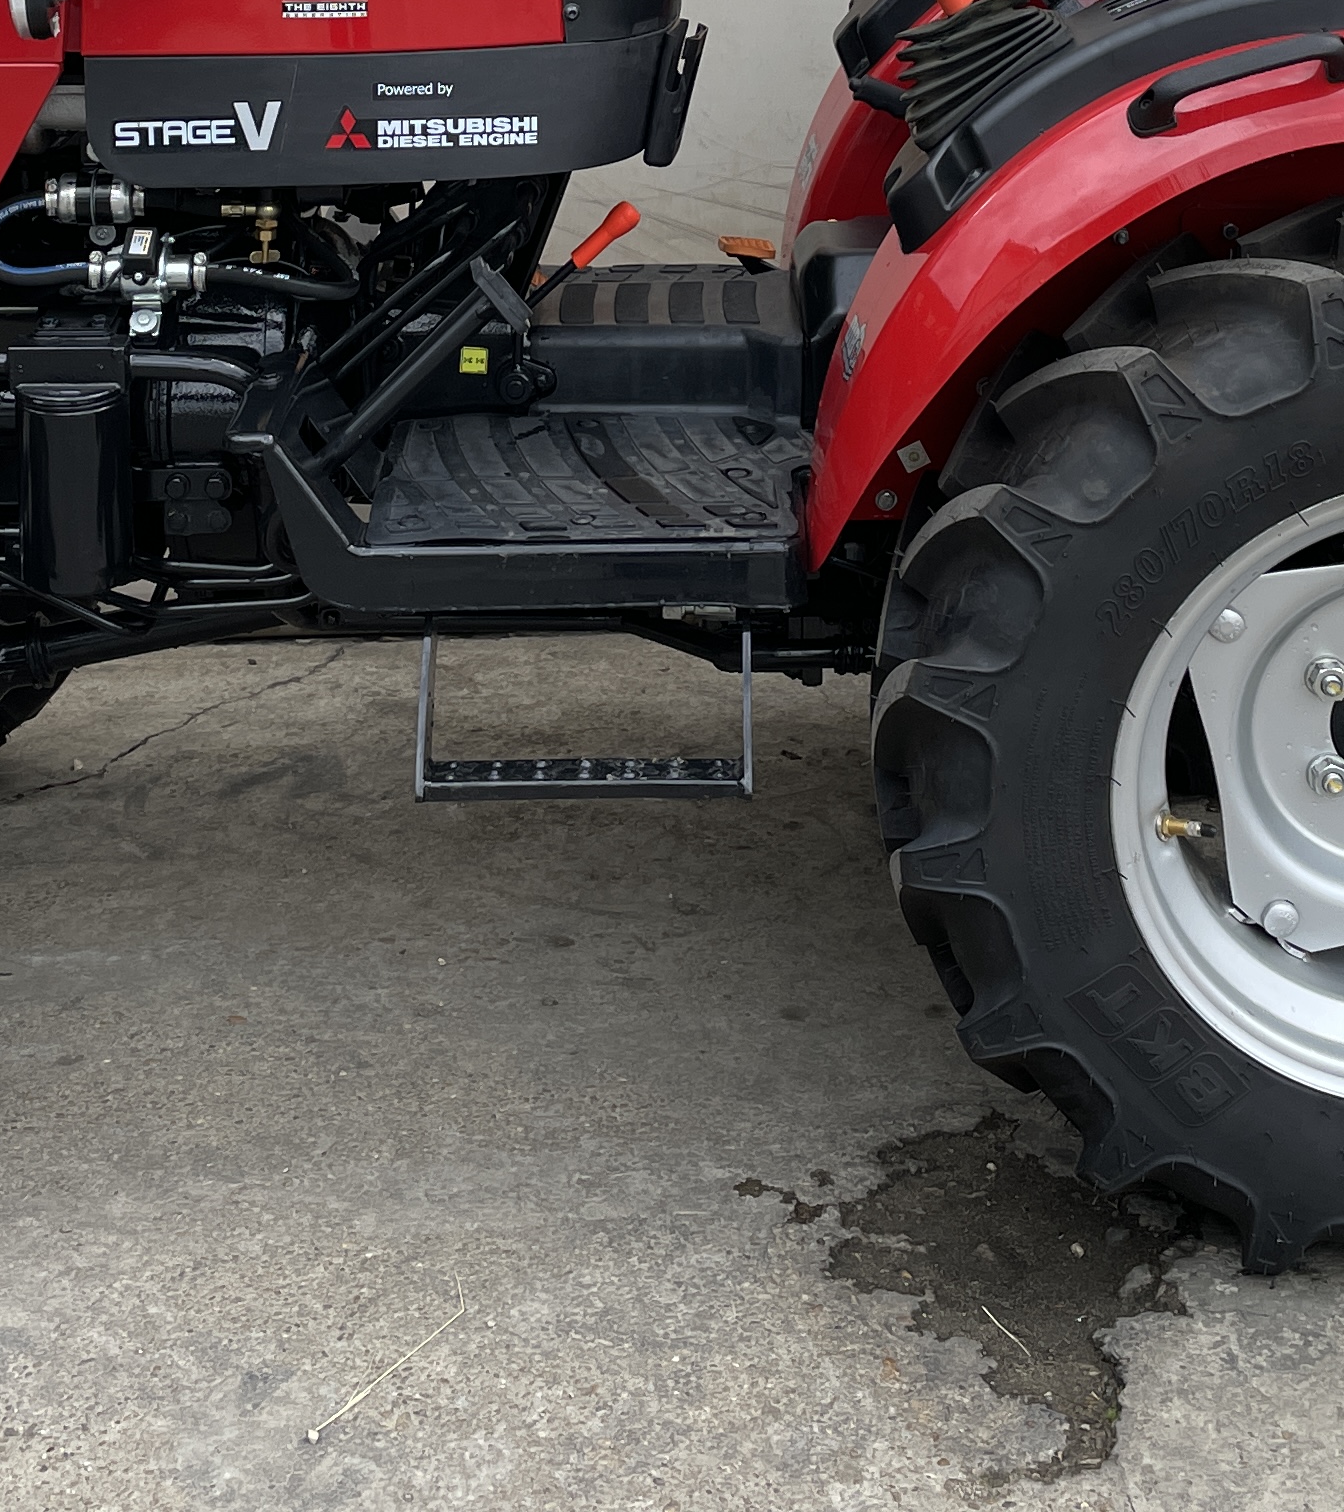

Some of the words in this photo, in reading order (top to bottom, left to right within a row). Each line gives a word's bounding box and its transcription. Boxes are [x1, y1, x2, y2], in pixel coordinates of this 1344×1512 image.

[285, 2, 312, 11] THE
[316, 2, 366, 11] EIGHTH
[377, 83, 433, 97] Powered
[436, 82, 454, 98] by
[114, 119, 236, 148] STAGE
[233, 101, 282, 151] V
[377, 116, 538, 136] MITSUBISHI
[377, 134, 454, 148] DIESEL
[458, 132, 538, 147] ENGINE
[1083, 968, 1242, 1124] BKT
